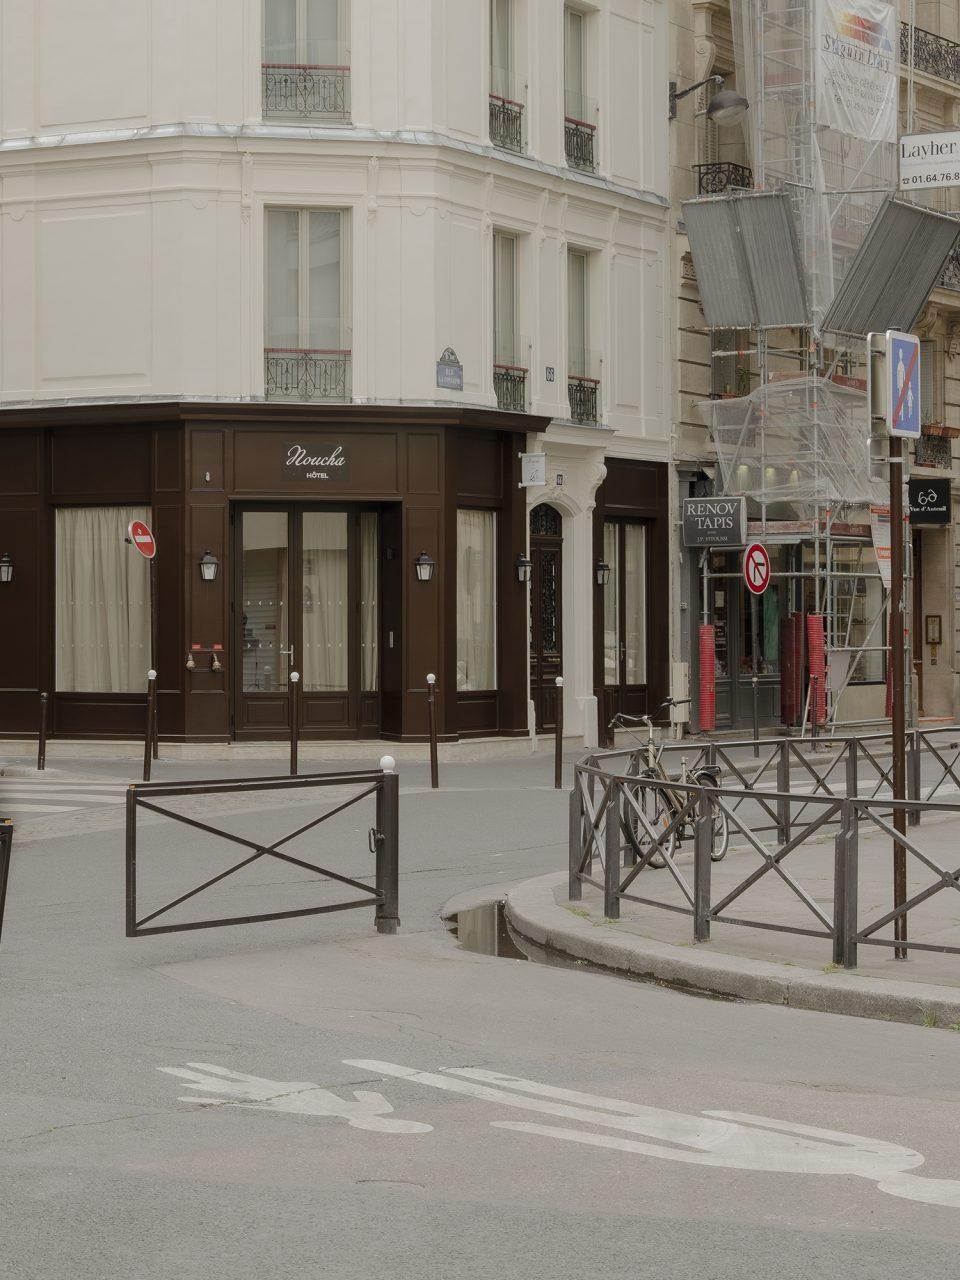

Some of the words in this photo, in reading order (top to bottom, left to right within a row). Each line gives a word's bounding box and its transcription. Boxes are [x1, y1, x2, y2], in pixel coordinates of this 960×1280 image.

[901, 141, 957, 160] Layher
[286, 445, 346, 466] Noucha
[306, 471, 329, 479] HÔTEL
[686, 503, 738, 515] RENOV
[695, 516, 734, 529] TAPIS
